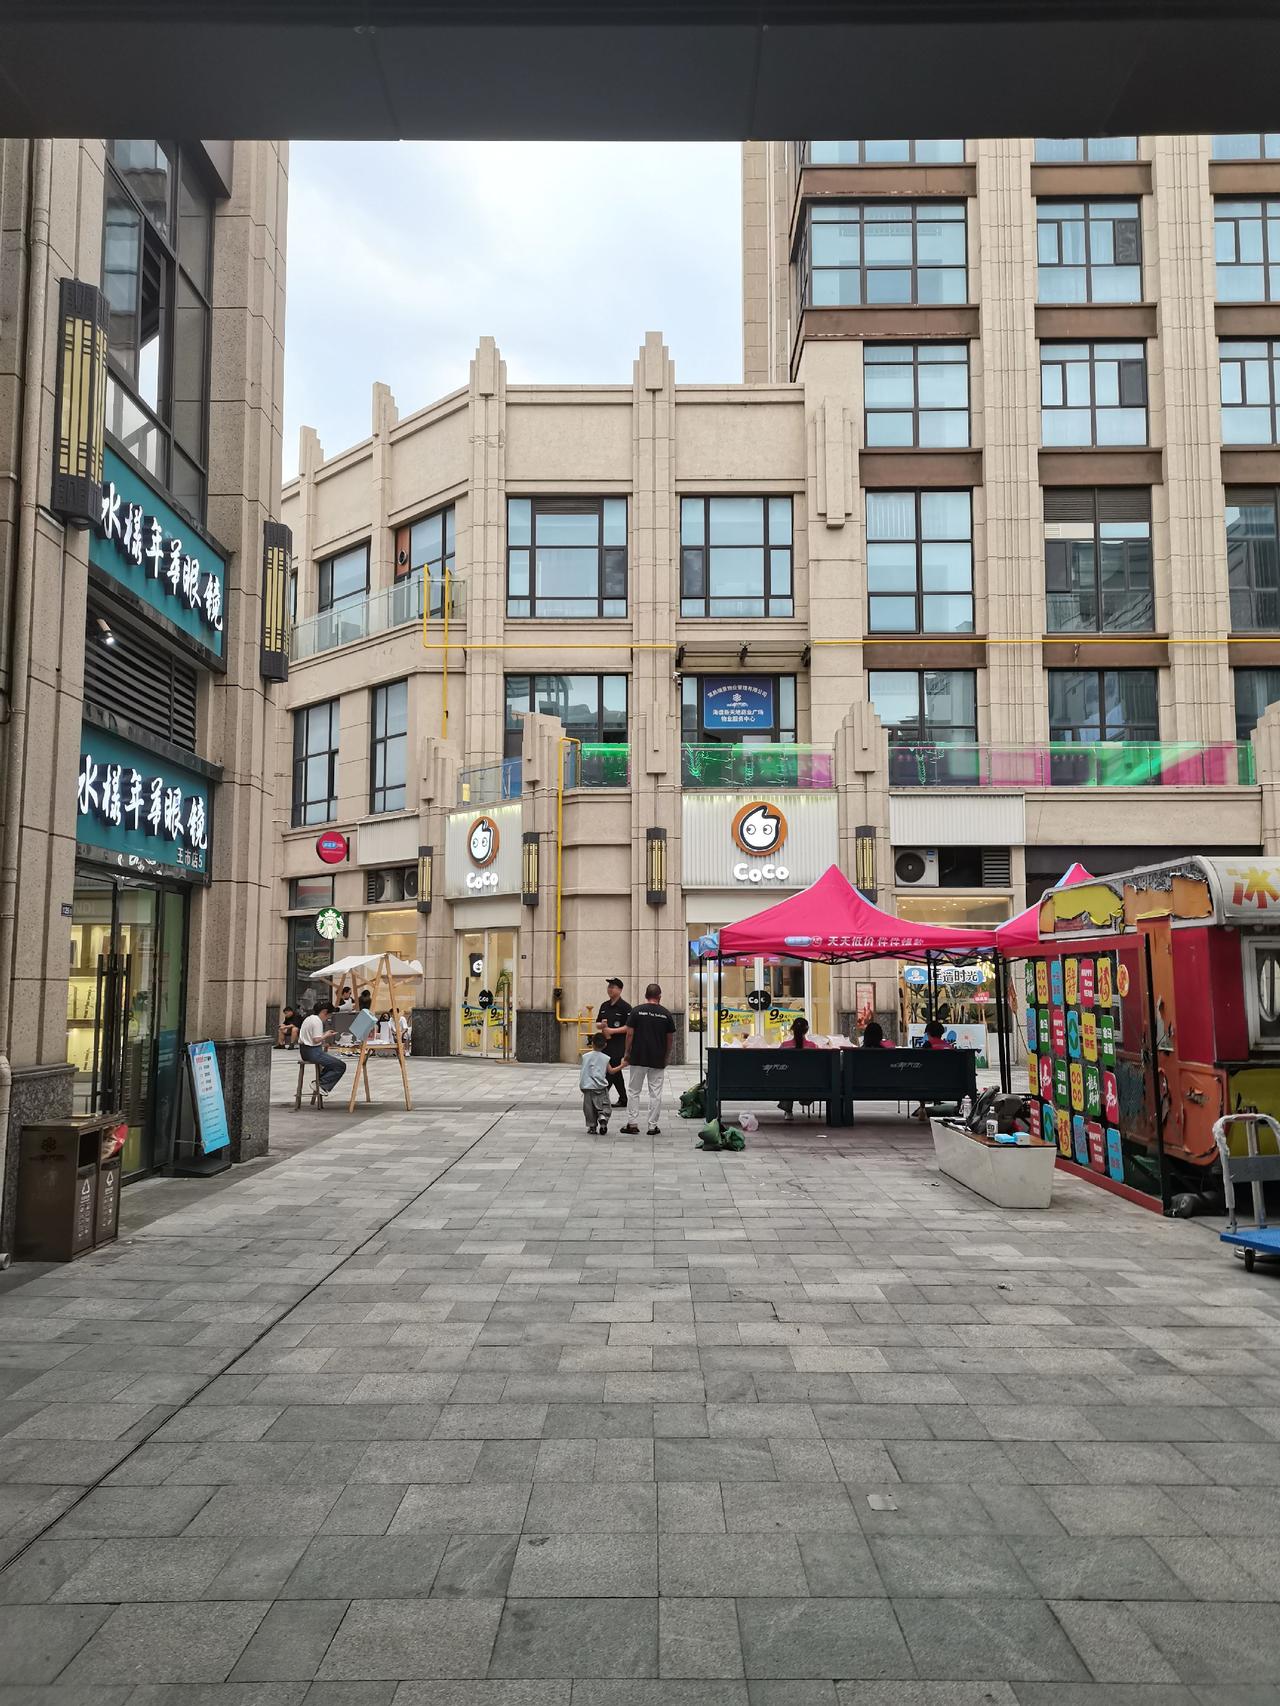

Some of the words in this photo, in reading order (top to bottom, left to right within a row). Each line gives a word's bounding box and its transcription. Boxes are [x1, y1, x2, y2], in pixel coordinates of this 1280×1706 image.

[466, 871, 499, 890] CoCo
[733, 862, 790, 883] CoCo
[827, 936, 874, 947] 天天低价
